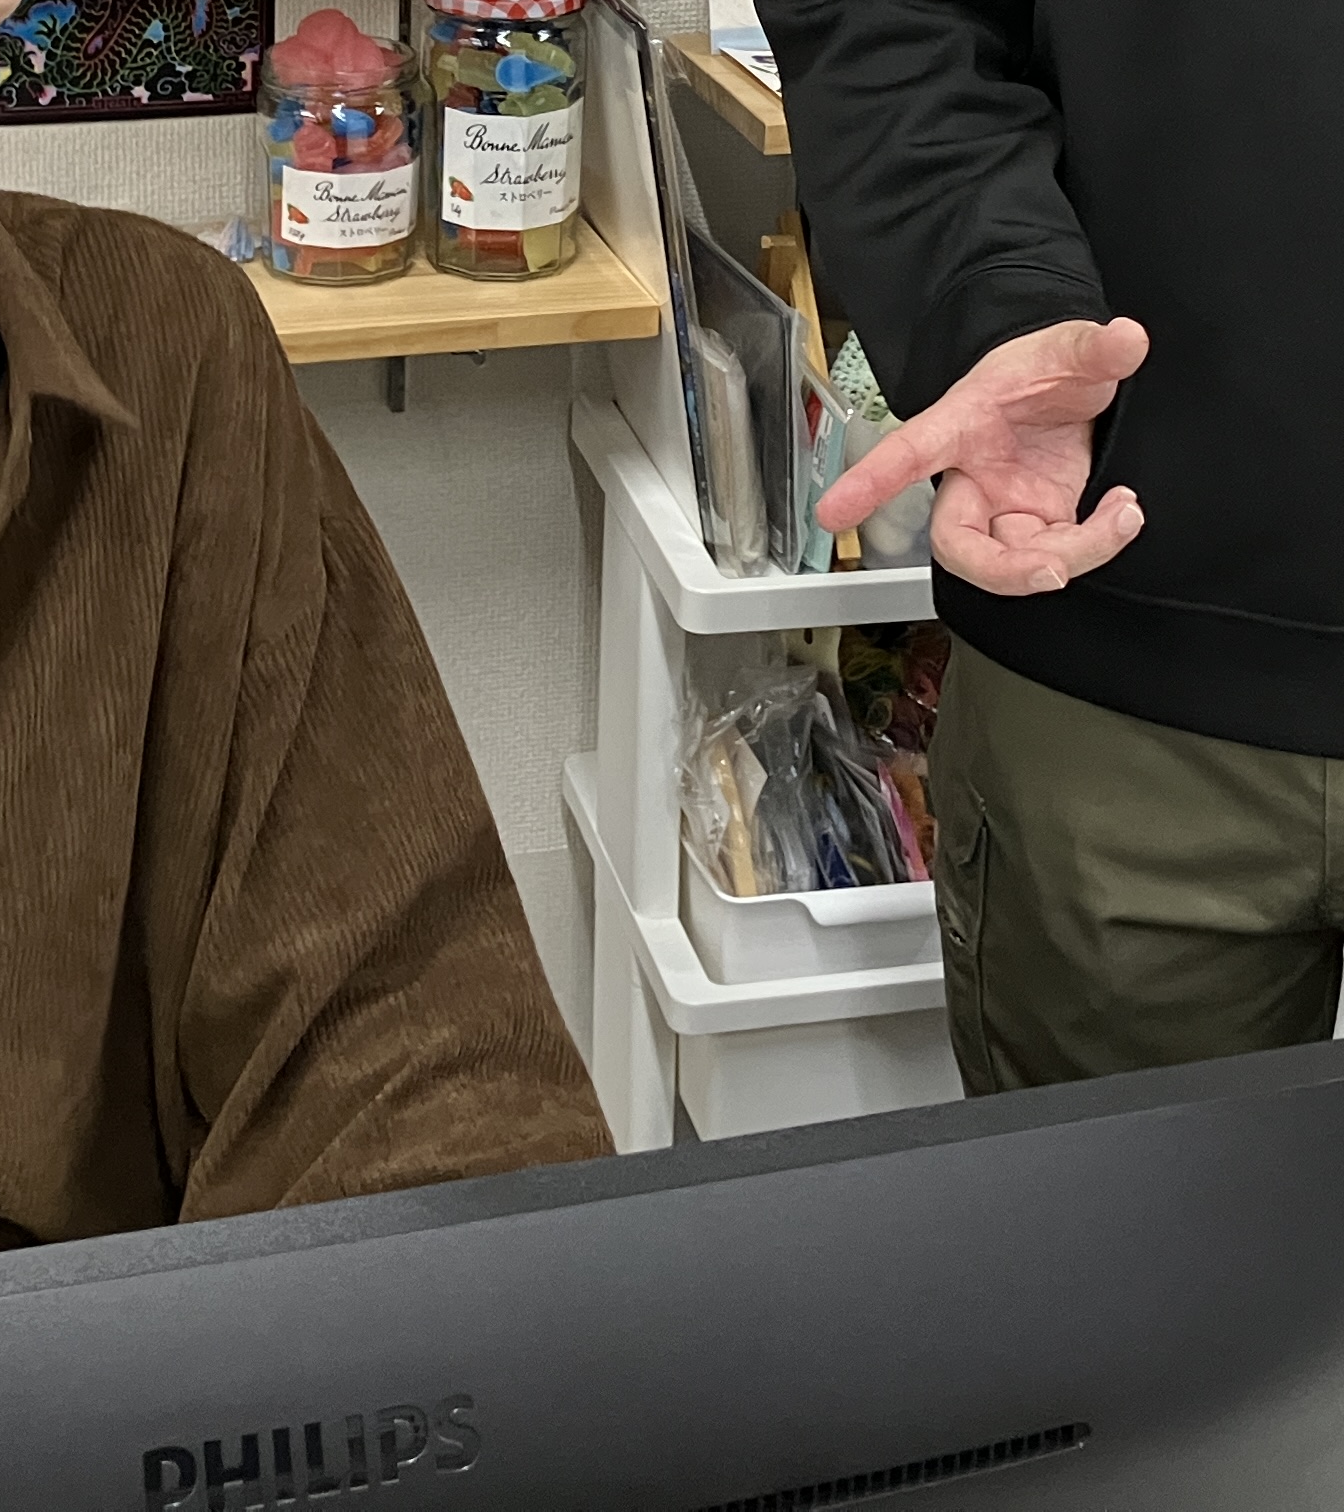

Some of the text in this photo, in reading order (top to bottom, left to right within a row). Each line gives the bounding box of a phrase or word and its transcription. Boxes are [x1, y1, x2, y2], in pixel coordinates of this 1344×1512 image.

[463, 123, 520, 152] Bonne
[480, 163, 567, 185] Strawberry
[499, 189, 552, 203] ストロベリー
[142, 1392, 482, 1512] PHILIPS
